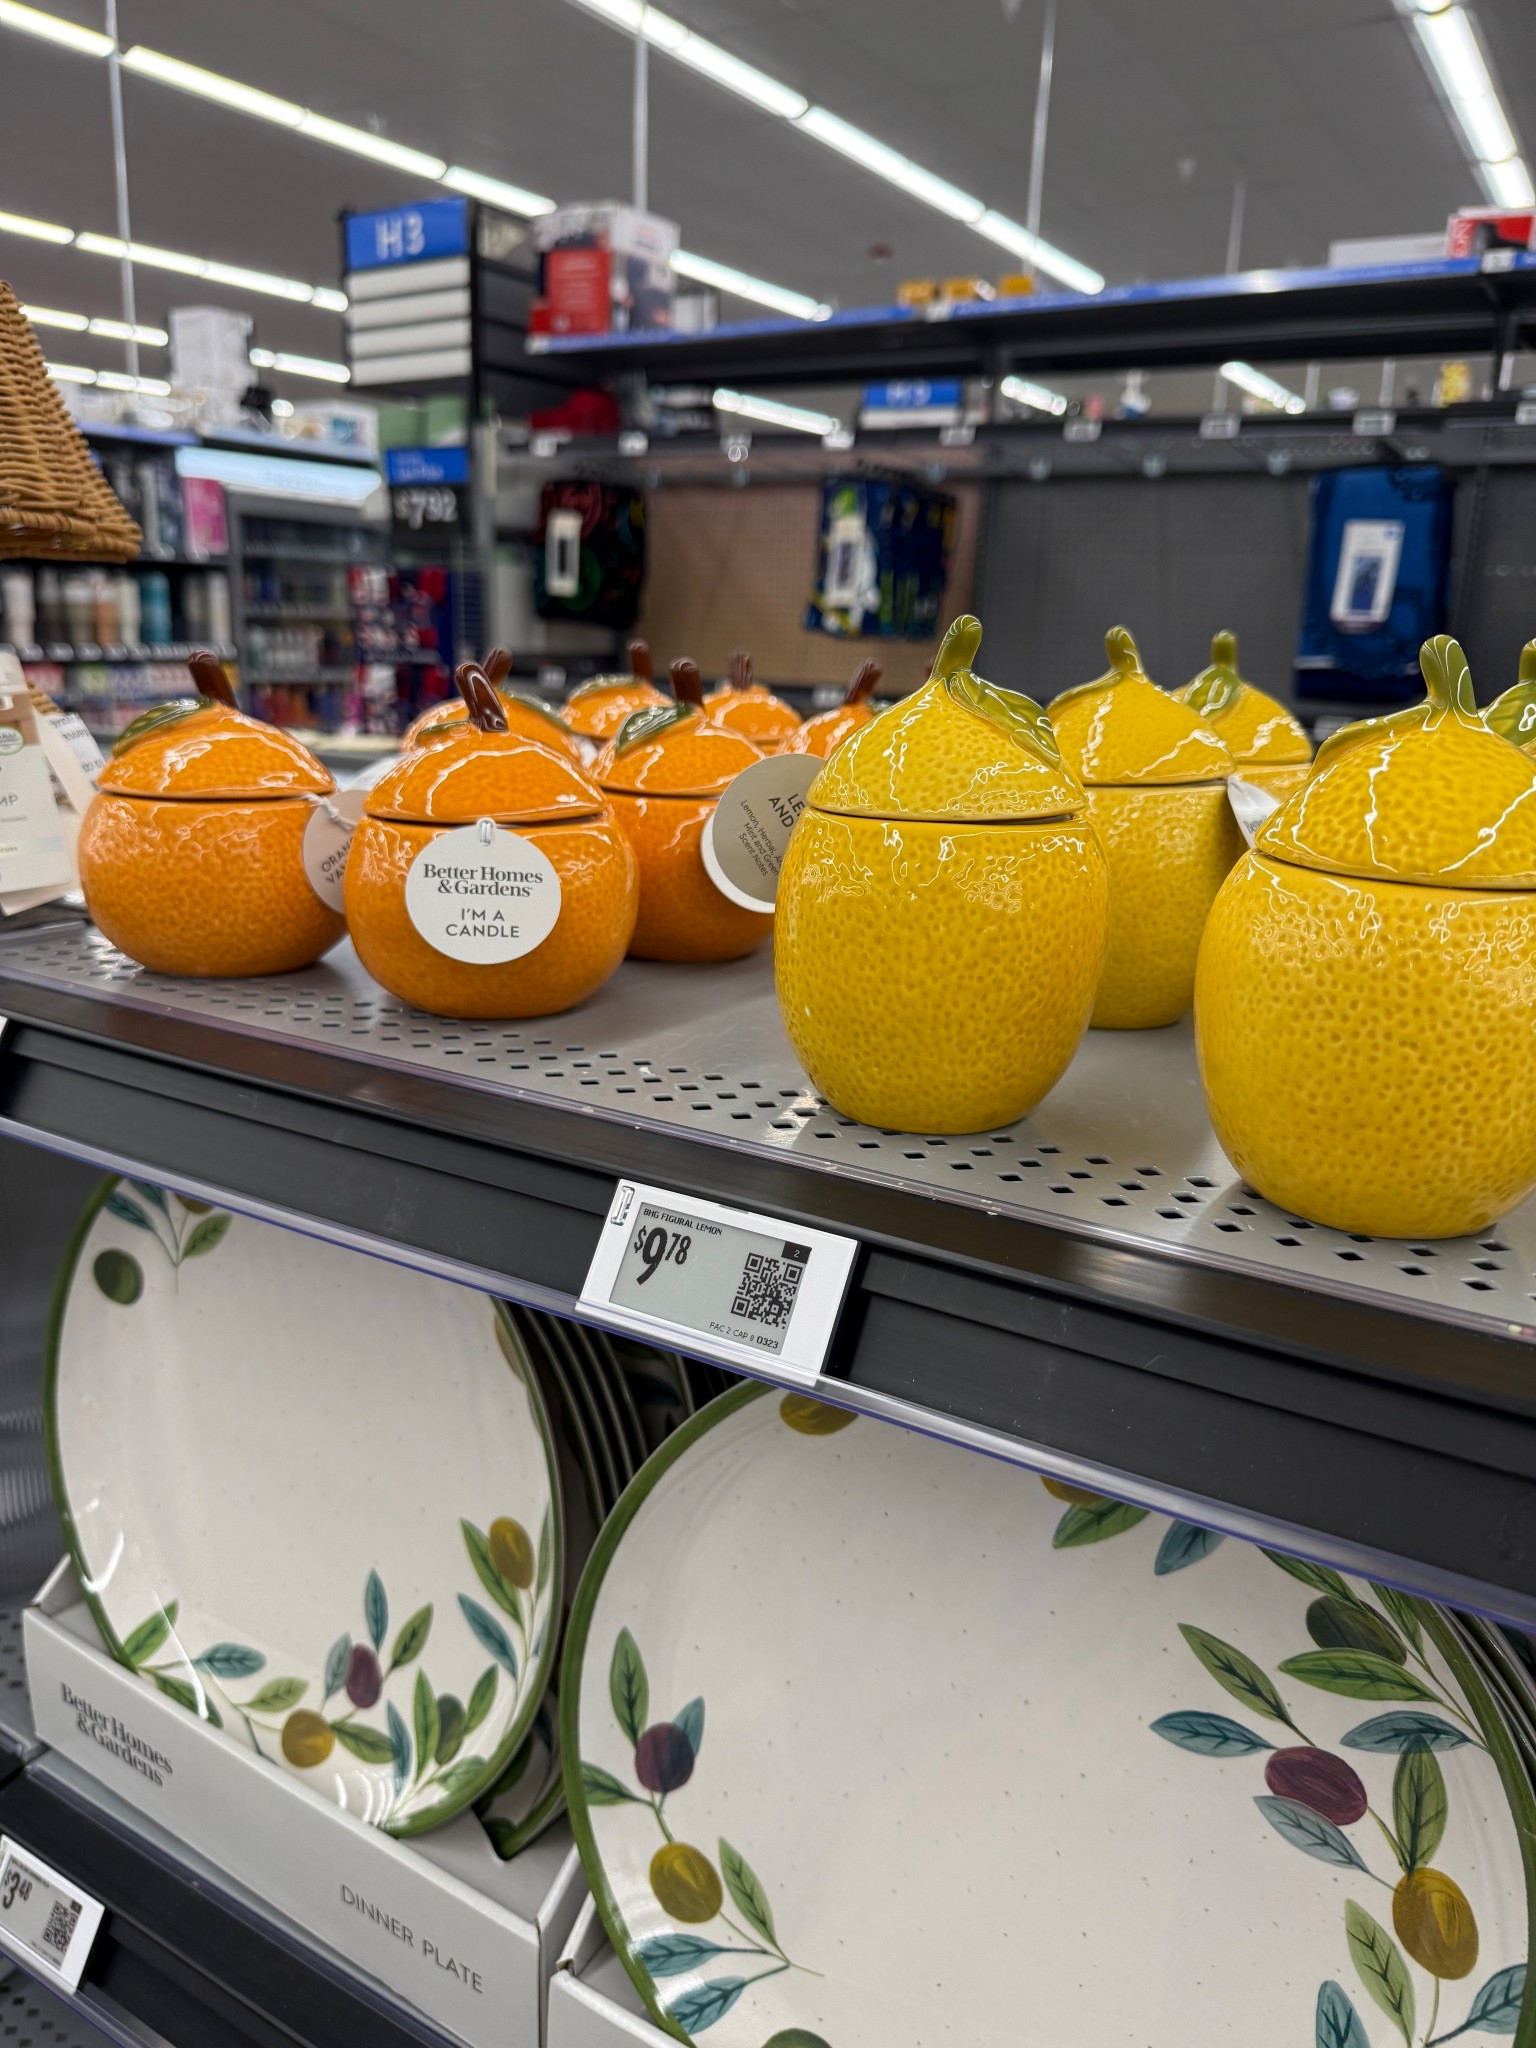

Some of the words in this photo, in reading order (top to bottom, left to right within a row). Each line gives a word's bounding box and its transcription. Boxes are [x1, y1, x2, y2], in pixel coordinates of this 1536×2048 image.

[375, 211, 425, 260] H3
[768, 797, 794, 827] AND
[787, 793, 805, 817] LE
[740, 800, 759, 828] Lemon,
[758, 827, 777, 855] Herbal,
[321, 836, 354, 873] ORAN
[739, 833, 756, 855] Scent
[753, 854, 769, 876] Notes
[743, 822, 757, 840] Mint
[754, 840, 767, 854] and
[763, 854, 779, 876] Green
[325, 862, 346, 883] VA
[423, 863, 478, 880] Better
[481, 866, 543, 884] Homes
[461, 908, 486, 921] I'M
[493, 910, 505, 921] A
[446, 924, 519, 938] CANDLE
[643, 1208, 660, 1219] BHG
[661, 1212, 693, 1229] FIGURAL
[696, 1222, 723, 1236] LEMON
[793, 1249, 800, 1258] 2
[709, 1321, 725, 1333] FAC
[726, 1327, 731, 1335] 2
[733, 1329, 748, 1339] CAP
[756, 1336, 779, 1349] 0323
[61, 1681, 109, 1729] Better
[111, 1716, 173, 1774] Homes
[342, 1884, 414, 1947] DINNER
[423, 1939, 483, 1993] PLATE
